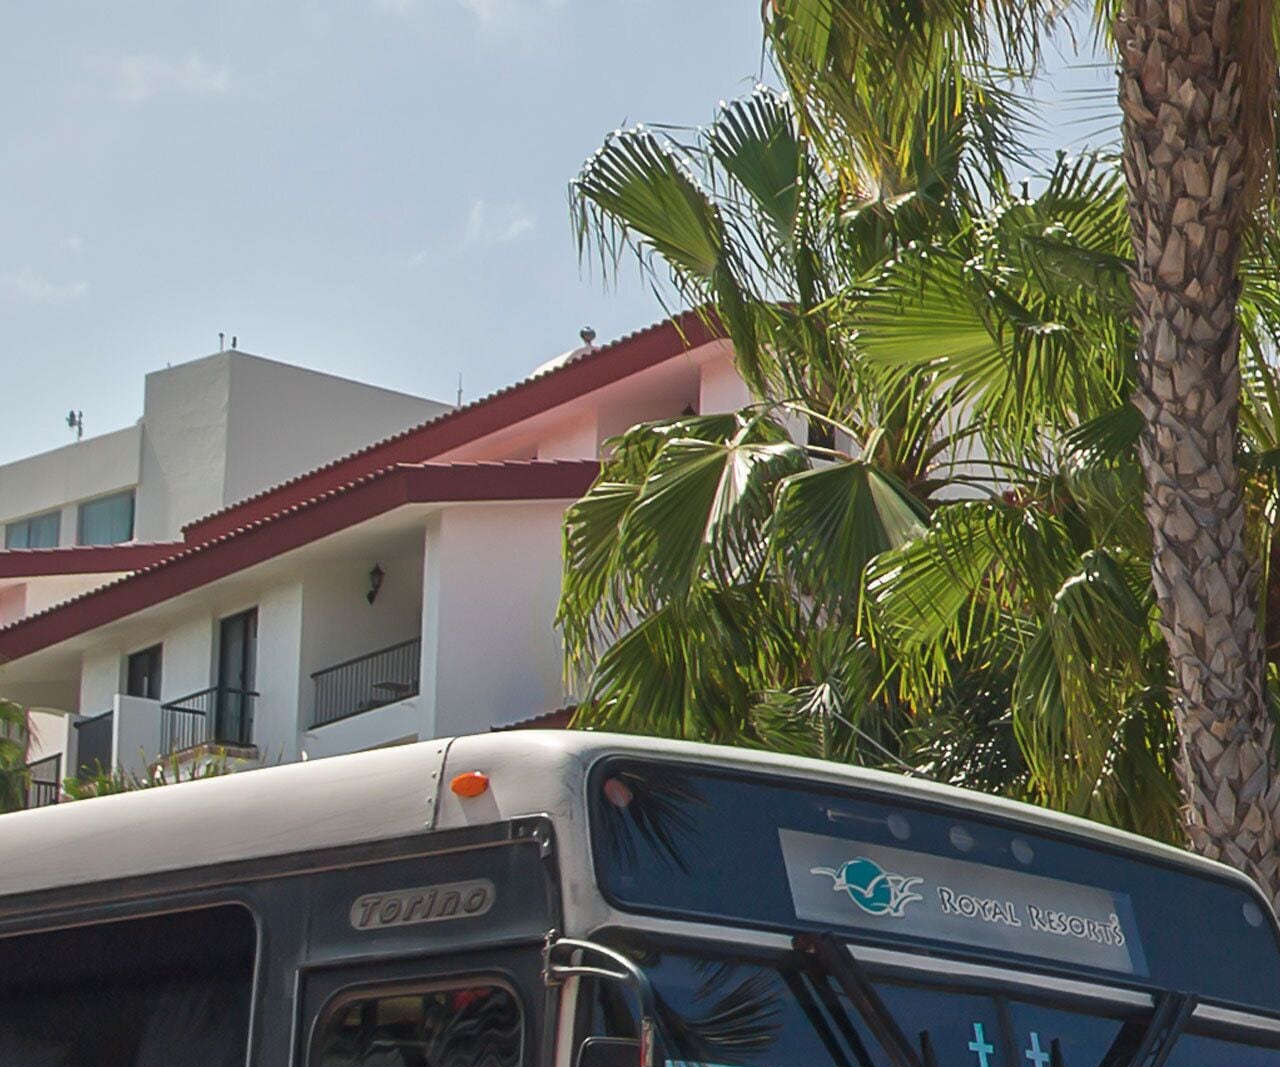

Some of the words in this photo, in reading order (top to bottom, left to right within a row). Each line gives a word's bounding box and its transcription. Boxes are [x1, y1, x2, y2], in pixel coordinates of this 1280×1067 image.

[358, 888, 489, 928] Torino
[937, 886, 1021, 926] ROYAL
[1026, 904, 1124, 946] RESORTS
